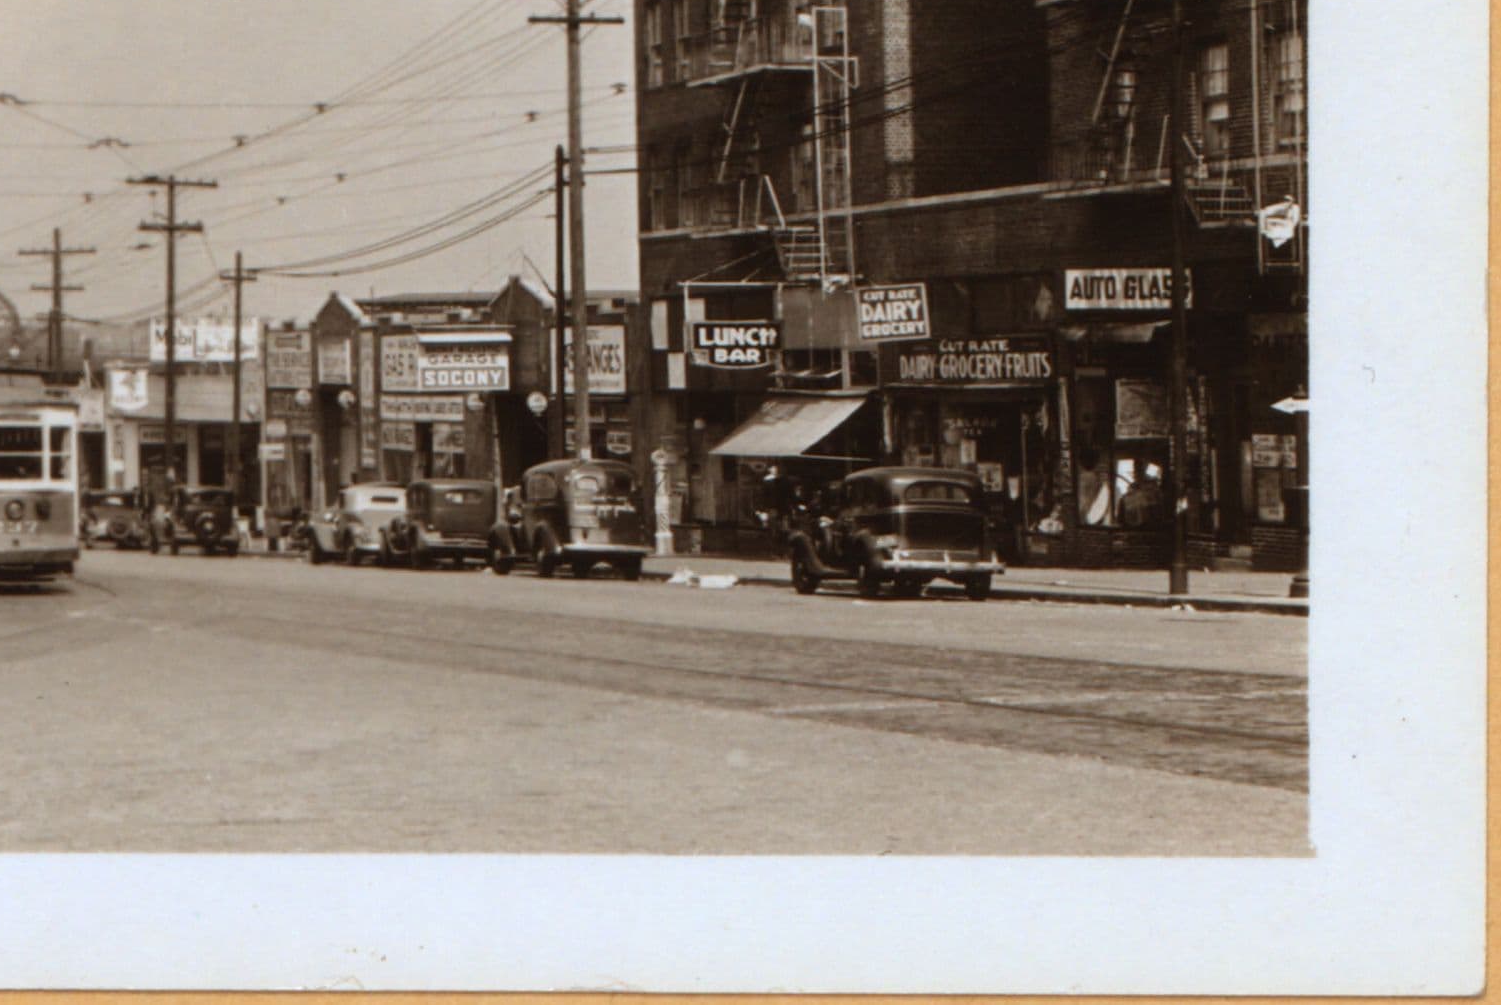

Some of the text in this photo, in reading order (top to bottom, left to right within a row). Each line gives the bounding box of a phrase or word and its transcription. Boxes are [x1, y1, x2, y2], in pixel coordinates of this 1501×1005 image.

[1069, 272, 1191, 301] AUTO GLAS
[860, 299, 921, 322] DAIRY
[698, 327, 777, 347] LUNCH
[861, 321, 925, 337] GROCERY
[939, 338, 1010, 352] CUT RATE
[427, 353, 498, 365] GARAGE
[713, 348, 761, 364] BAR
[424, 369, 501, 386] SOCONY
